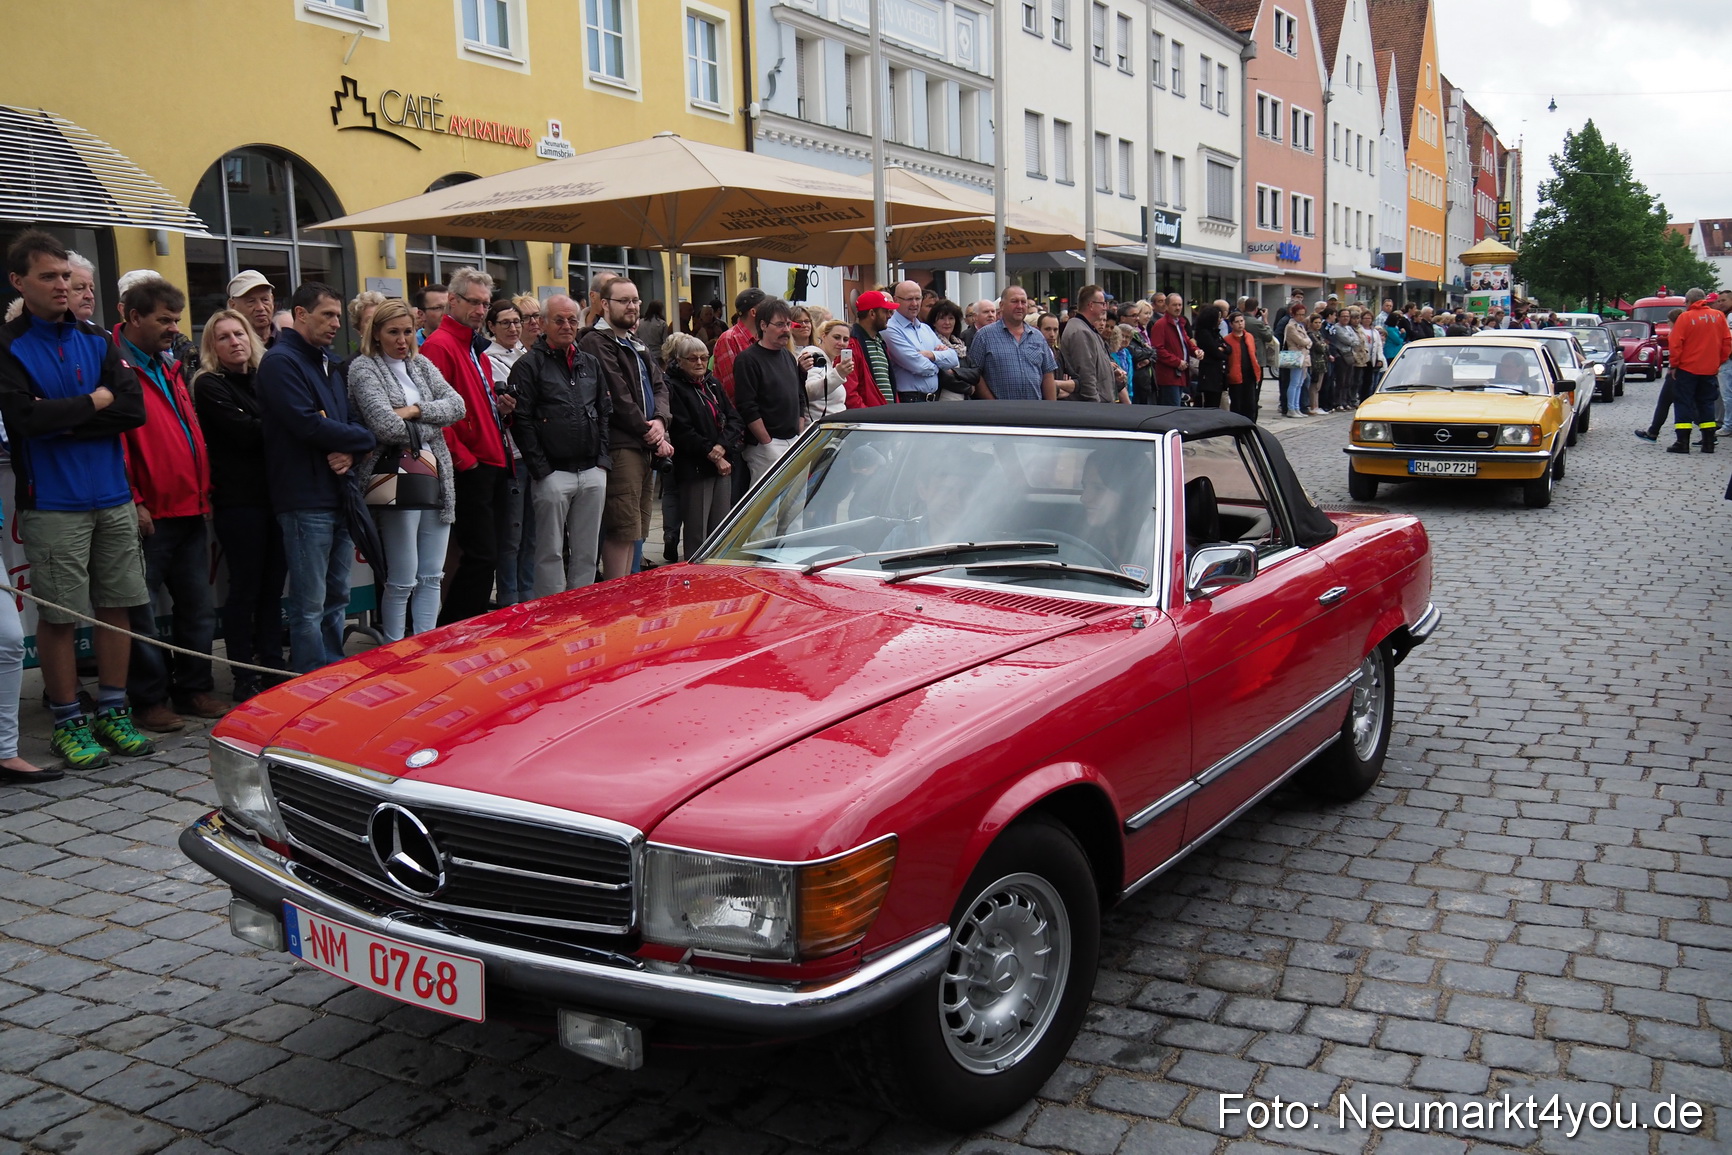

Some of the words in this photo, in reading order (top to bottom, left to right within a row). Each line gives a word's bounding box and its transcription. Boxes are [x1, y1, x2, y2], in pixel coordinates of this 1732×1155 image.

[380, 89, 445, 133] CAFÉ
[450, 114, 473, 137] AM
[474, 118, 533, 148] RATHAUS
[739, 272, 747, 282] 24
[309, 919, 349, 973] NM
[369, 942, 458, 1006] 0768
